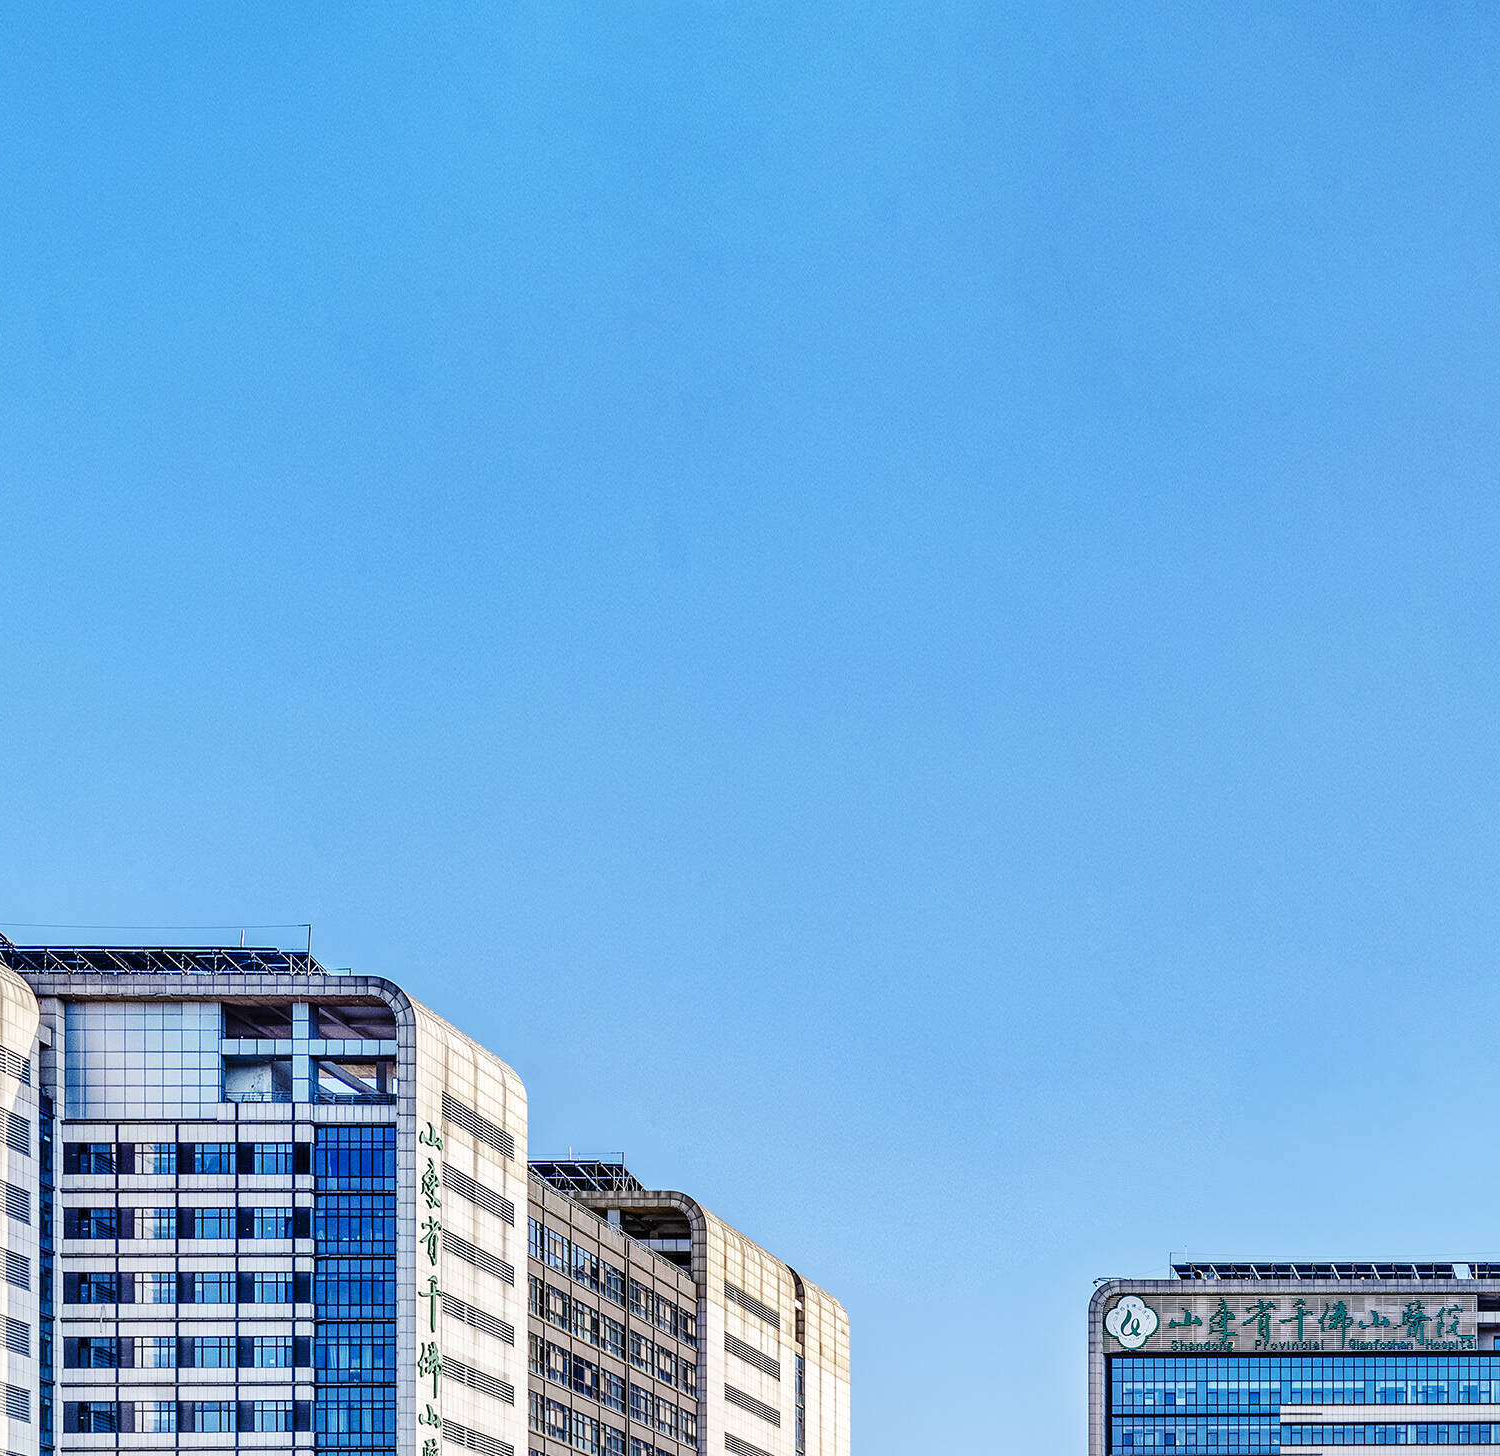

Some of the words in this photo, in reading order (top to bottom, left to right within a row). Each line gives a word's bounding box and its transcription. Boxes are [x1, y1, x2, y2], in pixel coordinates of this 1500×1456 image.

[1171, 1339, 1235, 1351] Shandong
[1255, 1339, 1325, 1351] Provincial
[1348, 1338, 1414, 1351] Qianfoshan
[1425, 1338, 1477, 1351] Hospital
